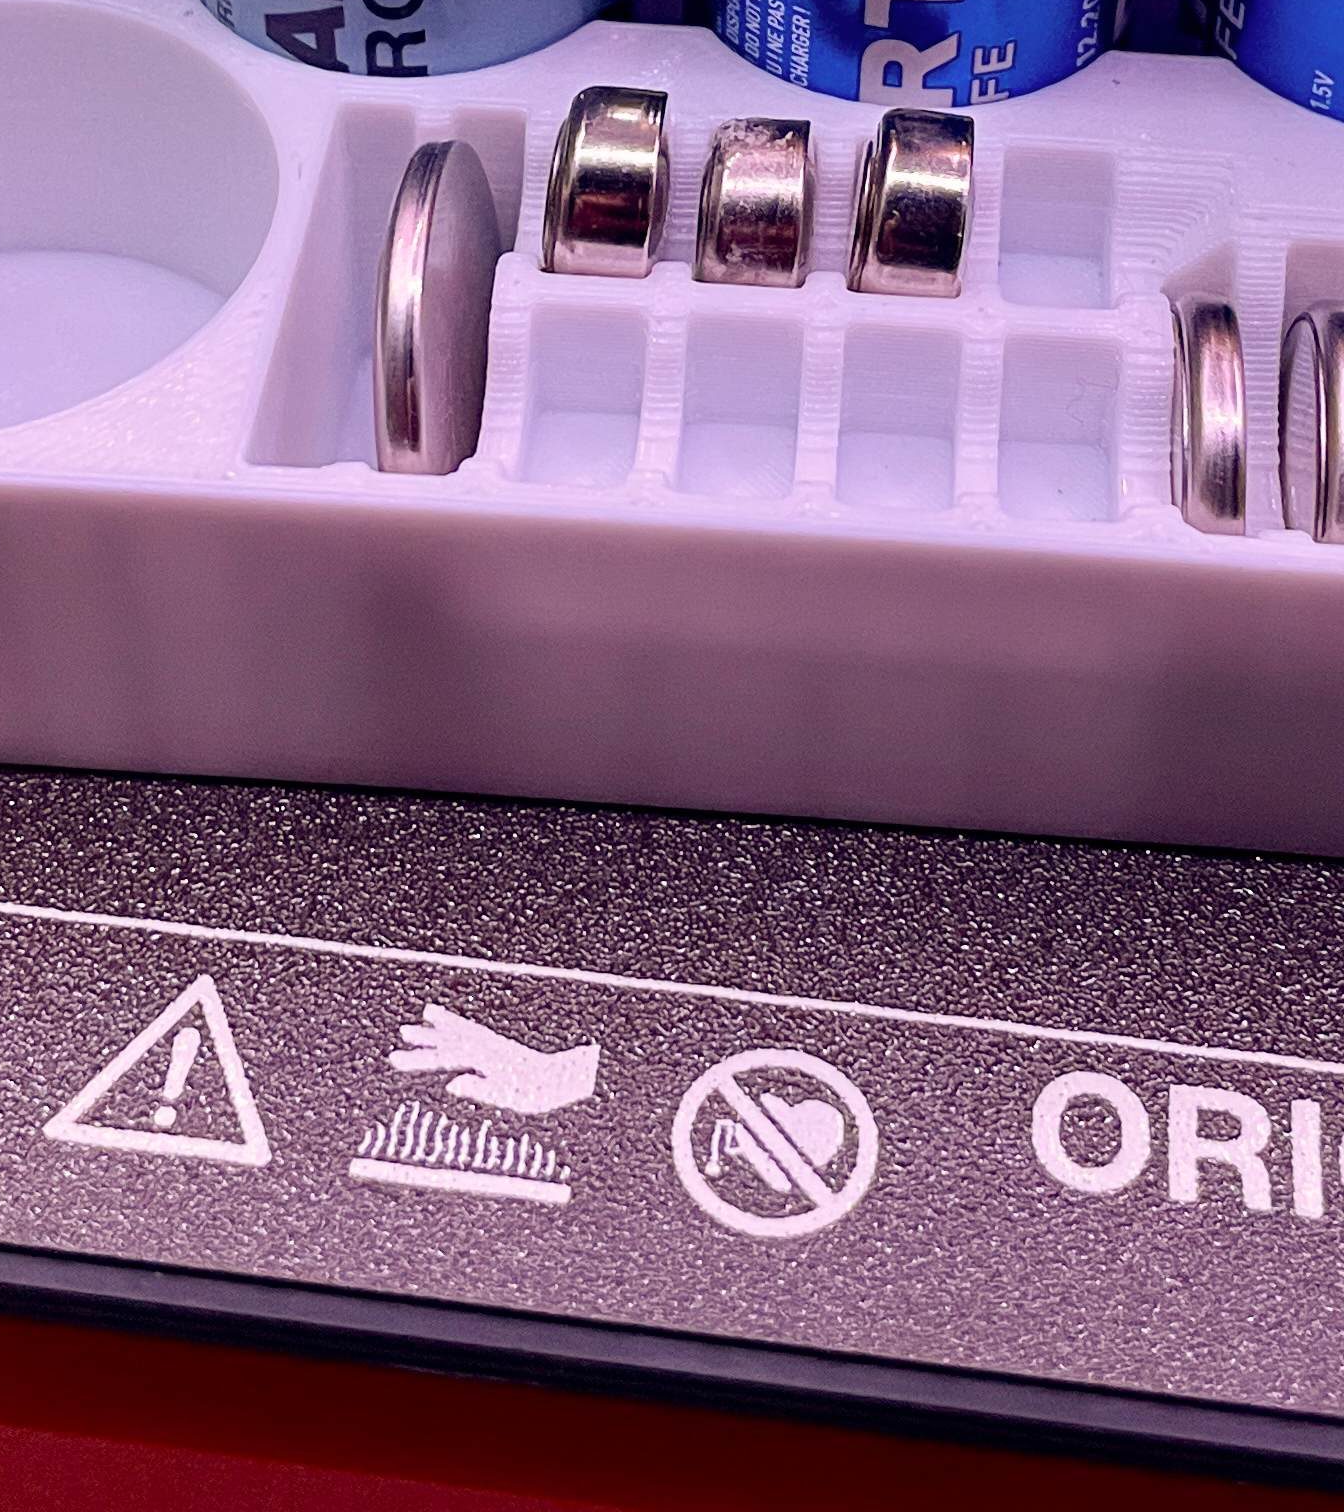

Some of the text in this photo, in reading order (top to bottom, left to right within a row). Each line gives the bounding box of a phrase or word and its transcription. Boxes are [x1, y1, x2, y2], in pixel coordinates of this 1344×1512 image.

[745, 3, 762, 34] NOT
[789, 17, 811, 87] CHARGER
[1310, 70, 1336, 111] 1.5V
